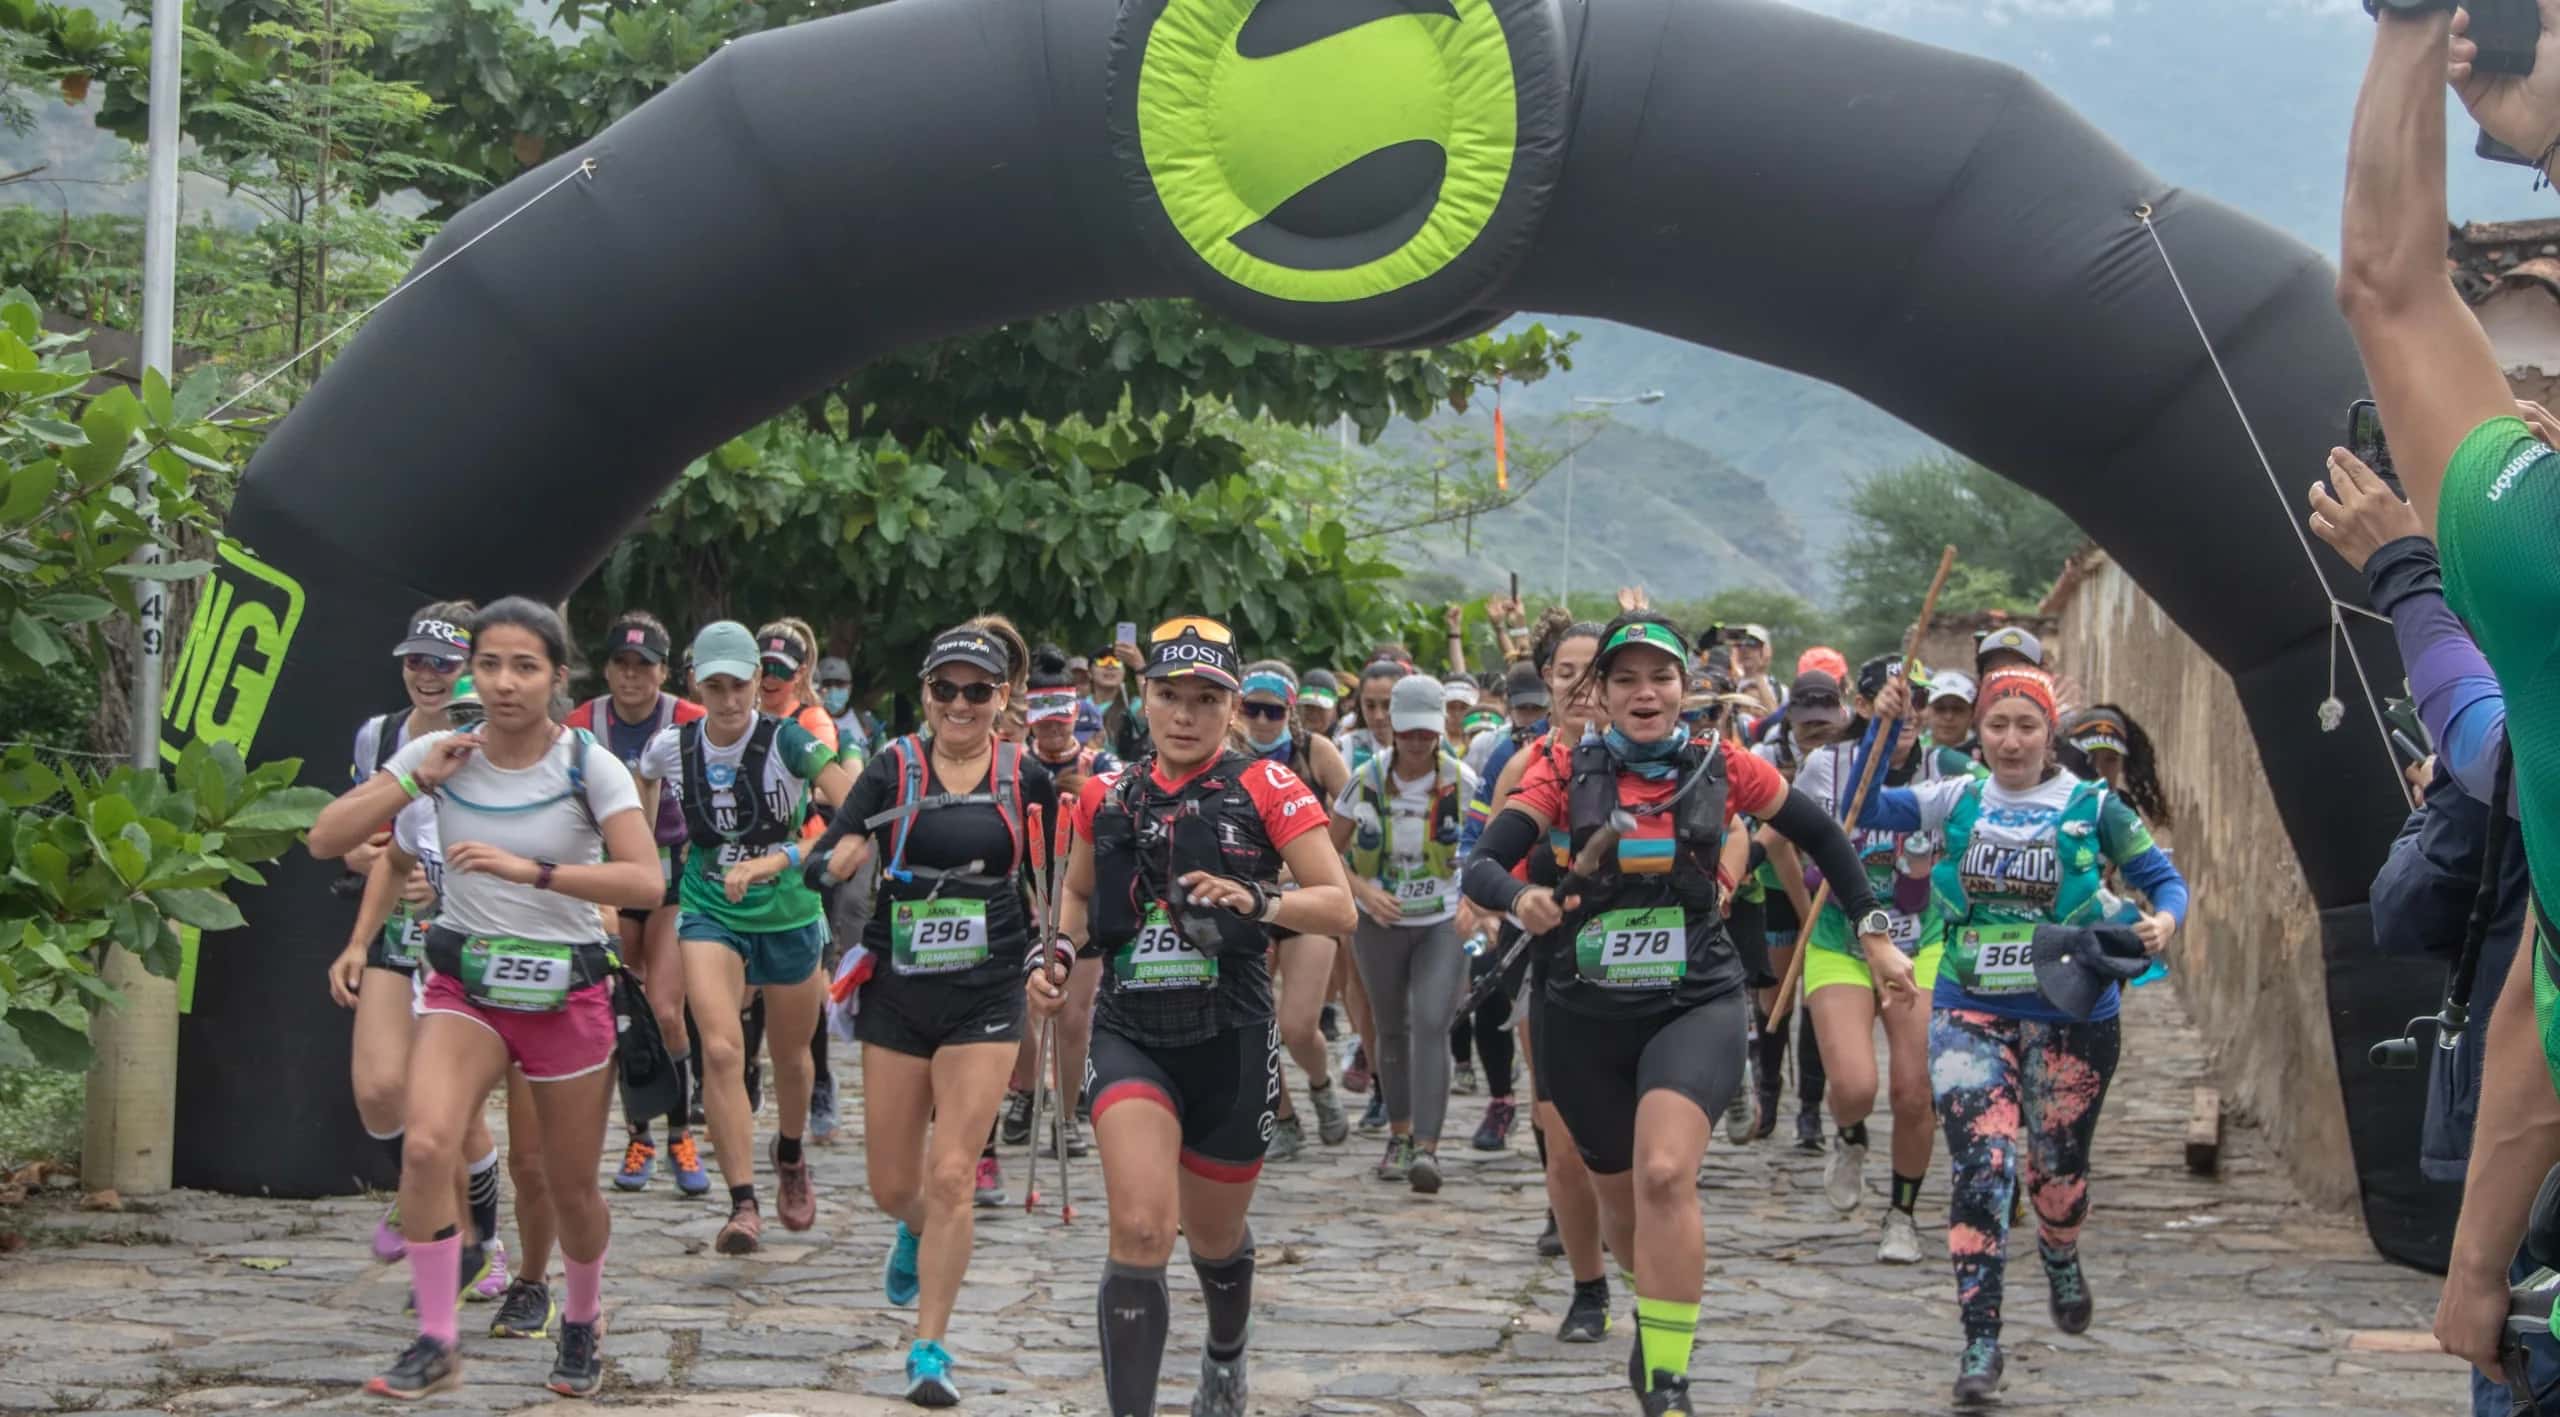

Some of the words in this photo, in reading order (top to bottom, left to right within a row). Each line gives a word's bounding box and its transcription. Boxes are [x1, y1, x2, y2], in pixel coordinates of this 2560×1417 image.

[1162, 644, 1224, 669] BOSI
[918, 919, 972, 945] 296
[1612, 931, 1671, 957] 370
[493, 957, 553, 982] 256
